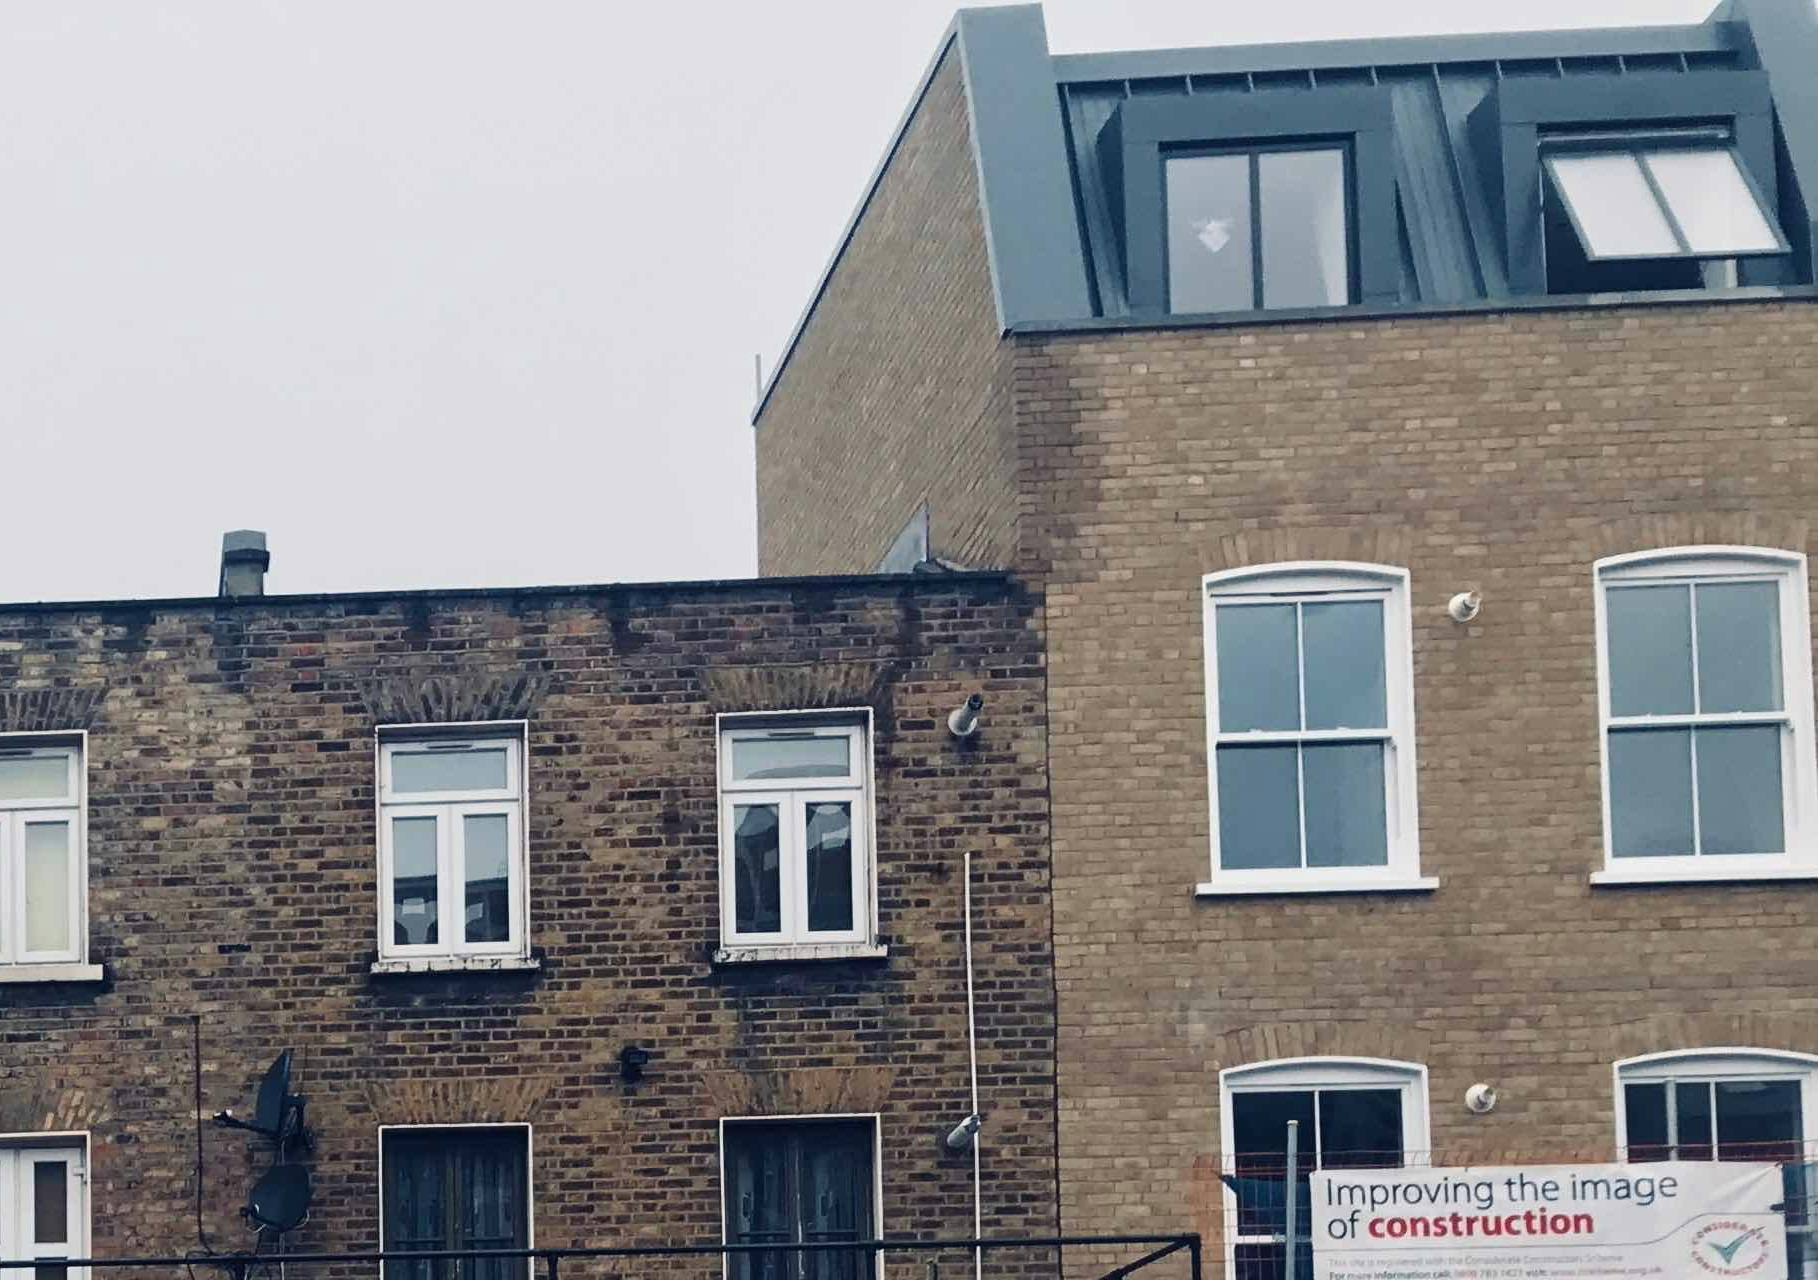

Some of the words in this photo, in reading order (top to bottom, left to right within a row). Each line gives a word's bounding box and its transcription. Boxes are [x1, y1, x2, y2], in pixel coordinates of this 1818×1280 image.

[1327, 1176, 1494, 1212] Improving
[1504, 1173, 1559, 1202] the
[1570, 1174, 1678, 1206] image
[1328, 1209, 1361, 1239] of
[1368, 1207, 1594, 1238] construction
[1374, 1270, 1431, 1280] information
